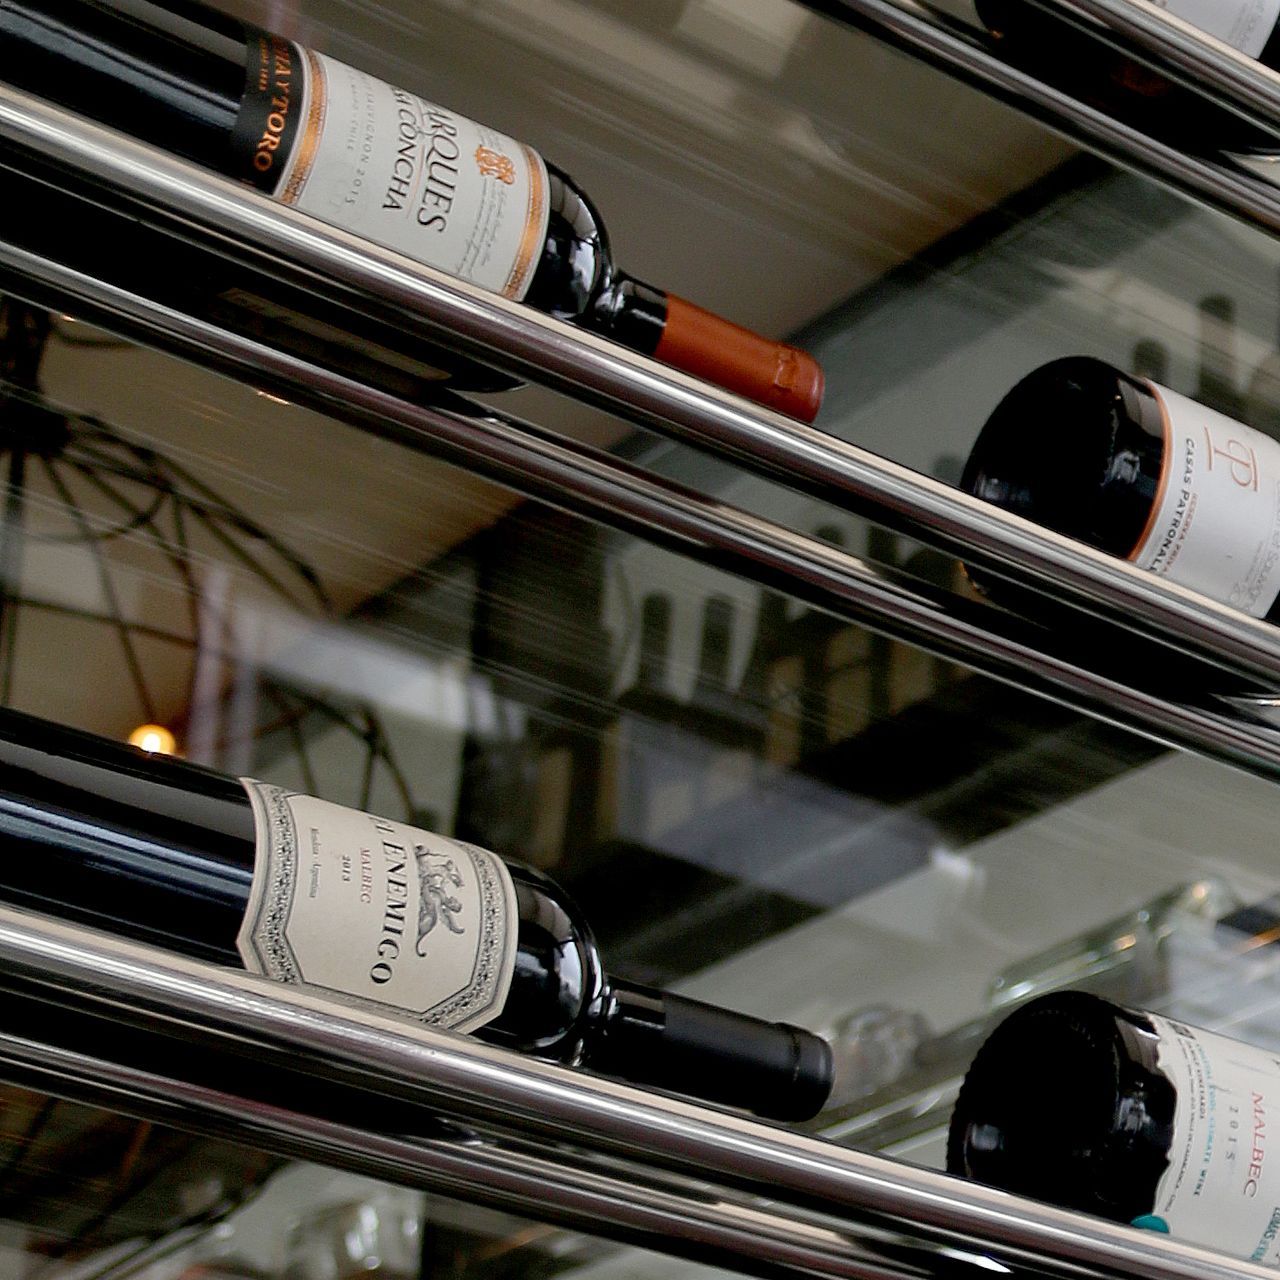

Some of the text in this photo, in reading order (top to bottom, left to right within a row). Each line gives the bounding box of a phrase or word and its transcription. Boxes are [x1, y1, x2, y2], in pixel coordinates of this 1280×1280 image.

[251, 96, 288, 173] TORO
[382, 109, 418, 213] CONCHA
[416, 105, 460, 235] ARQUES
[343, 167, 365, 205] 2015
[1148, 437, 1193, 574] CASAS PATRONAL
[342, 854, 350, 882] 2013
[359, 847, 370, 904] MALBEC
[367, 840, 407, 985] ENEMIGO
[1223, 1105, 1238, 1161] 2015
[1242, 1092, 1265, 1198] MALBEC
[1192, 1168, 1207, 1197] WINE
